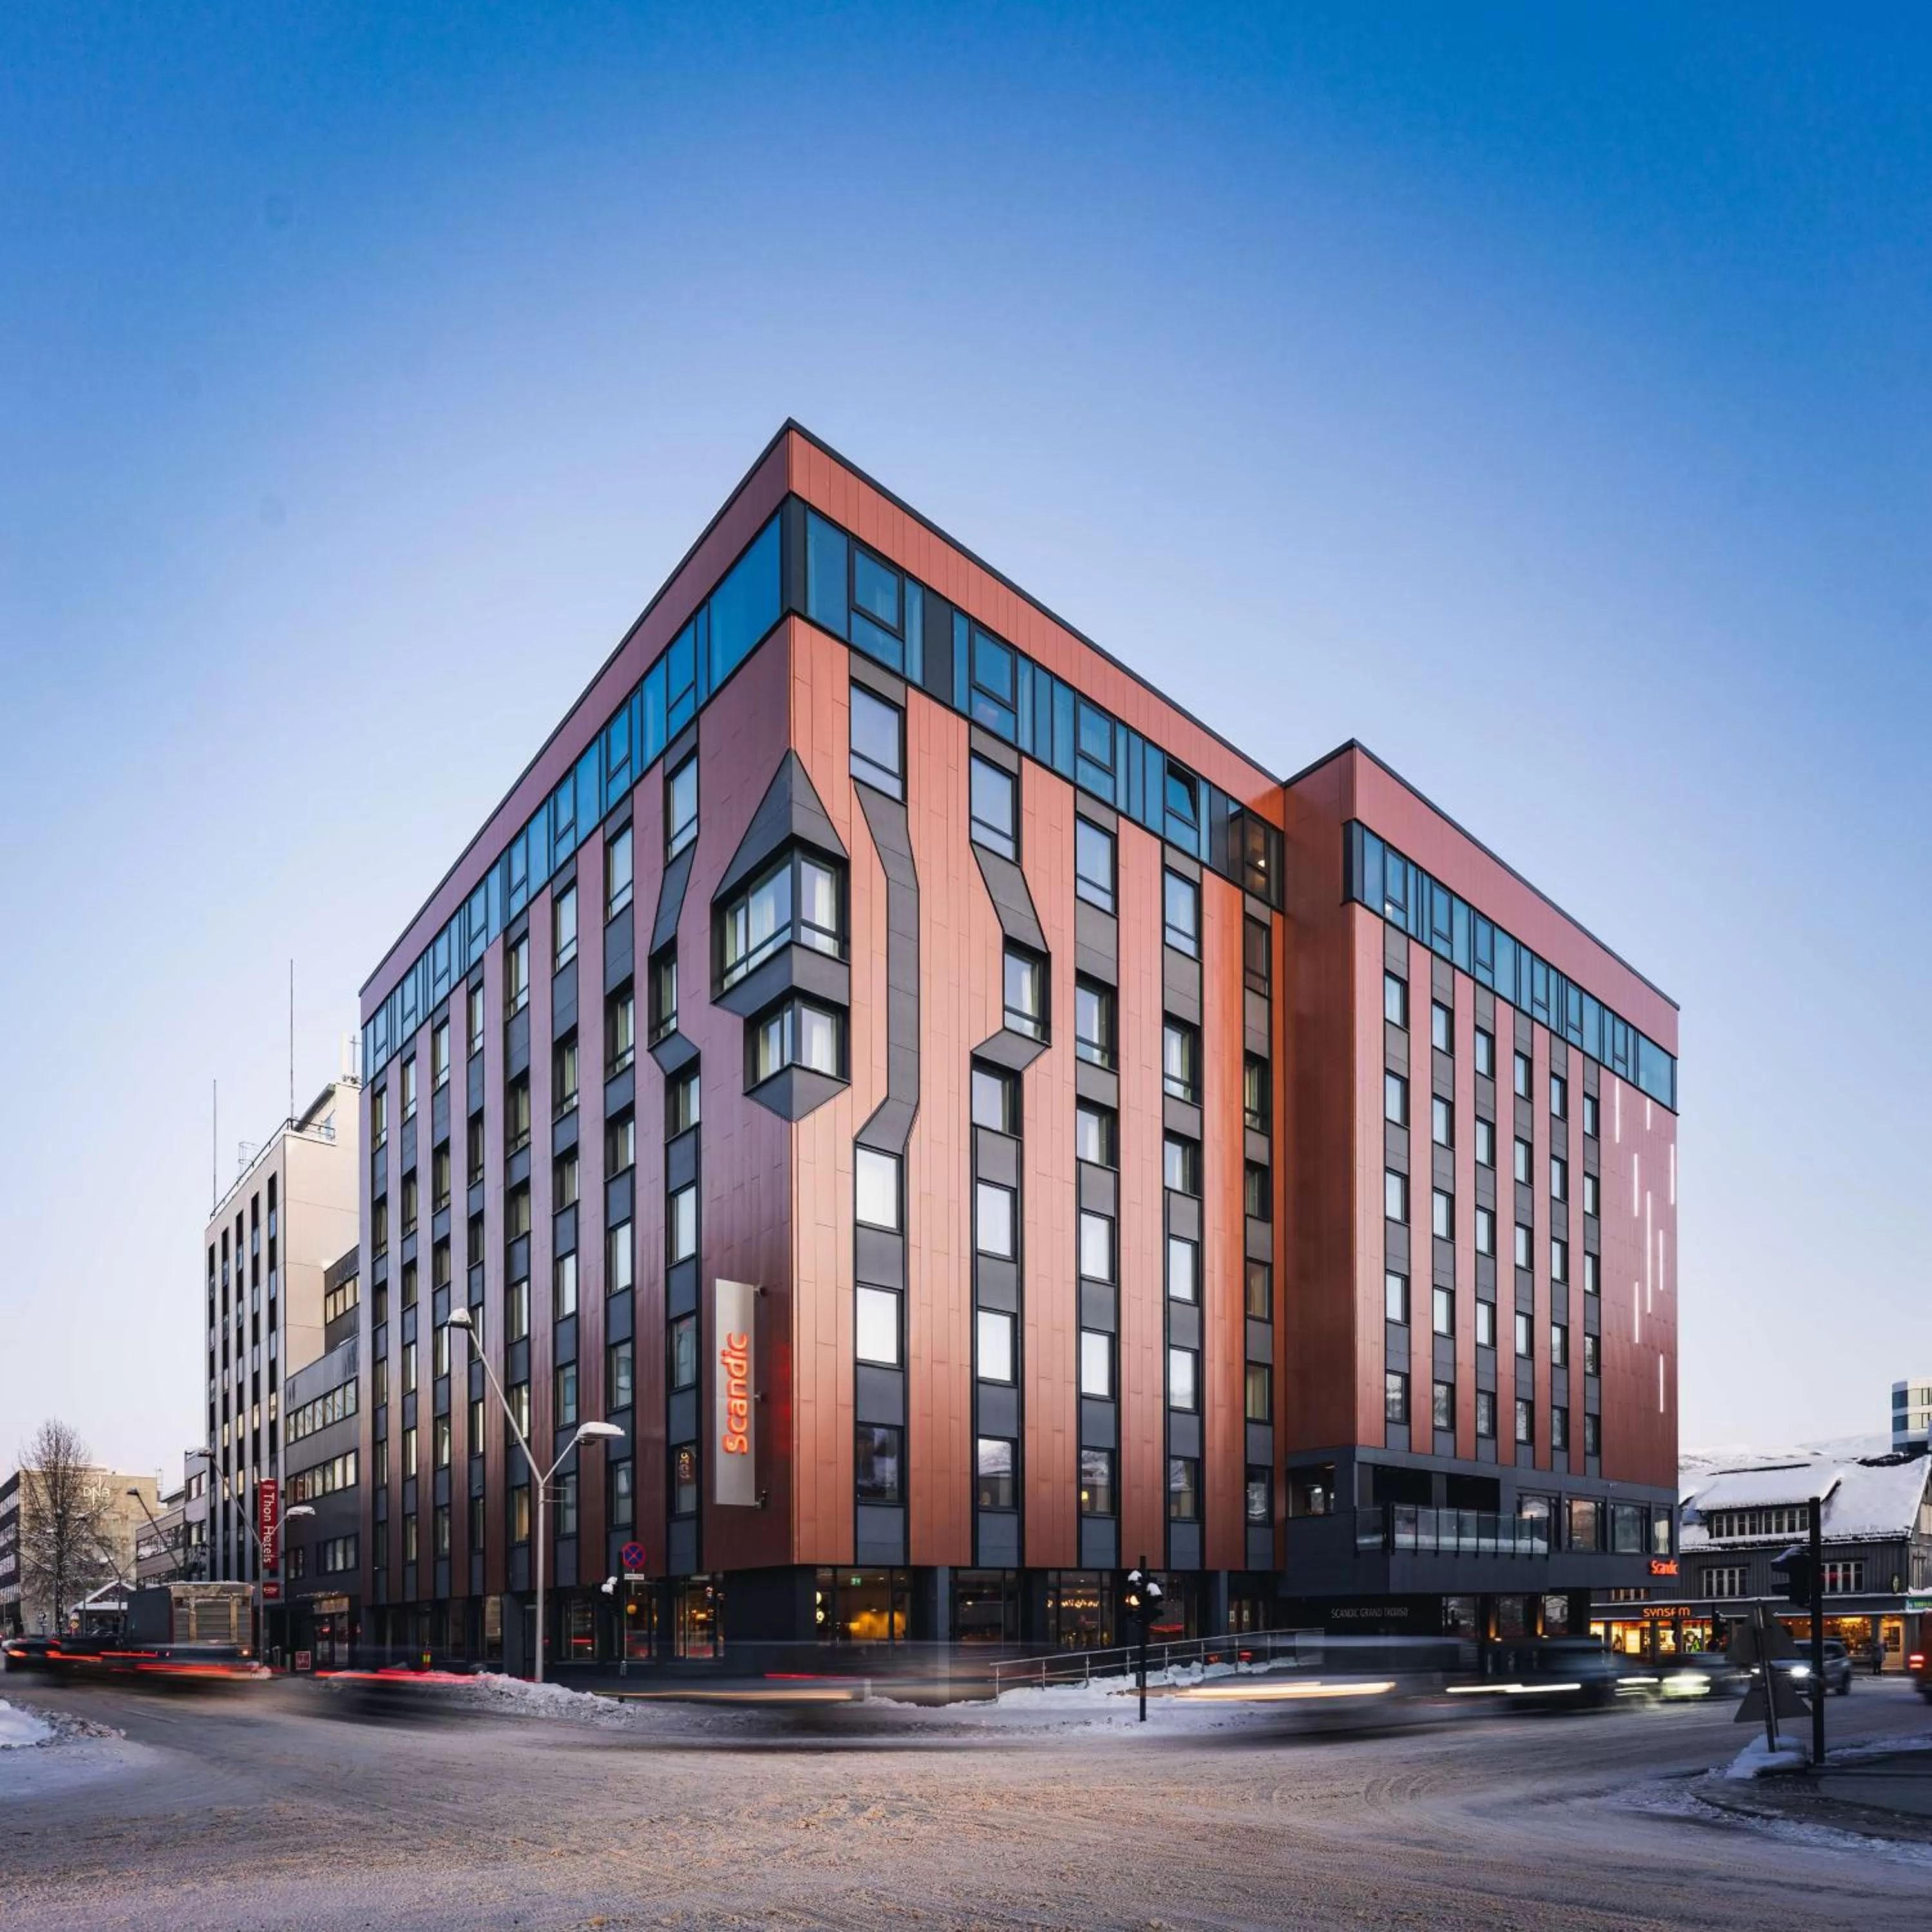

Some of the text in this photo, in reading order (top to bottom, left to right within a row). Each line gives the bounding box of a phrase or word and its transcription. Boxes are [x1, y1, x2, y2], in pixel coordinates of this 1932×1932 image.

[721, 1332, 748, 1455] Scandic
[263, 1492, 275, 1522] Thon
[263, 1526, 274, 1564] Hotels
